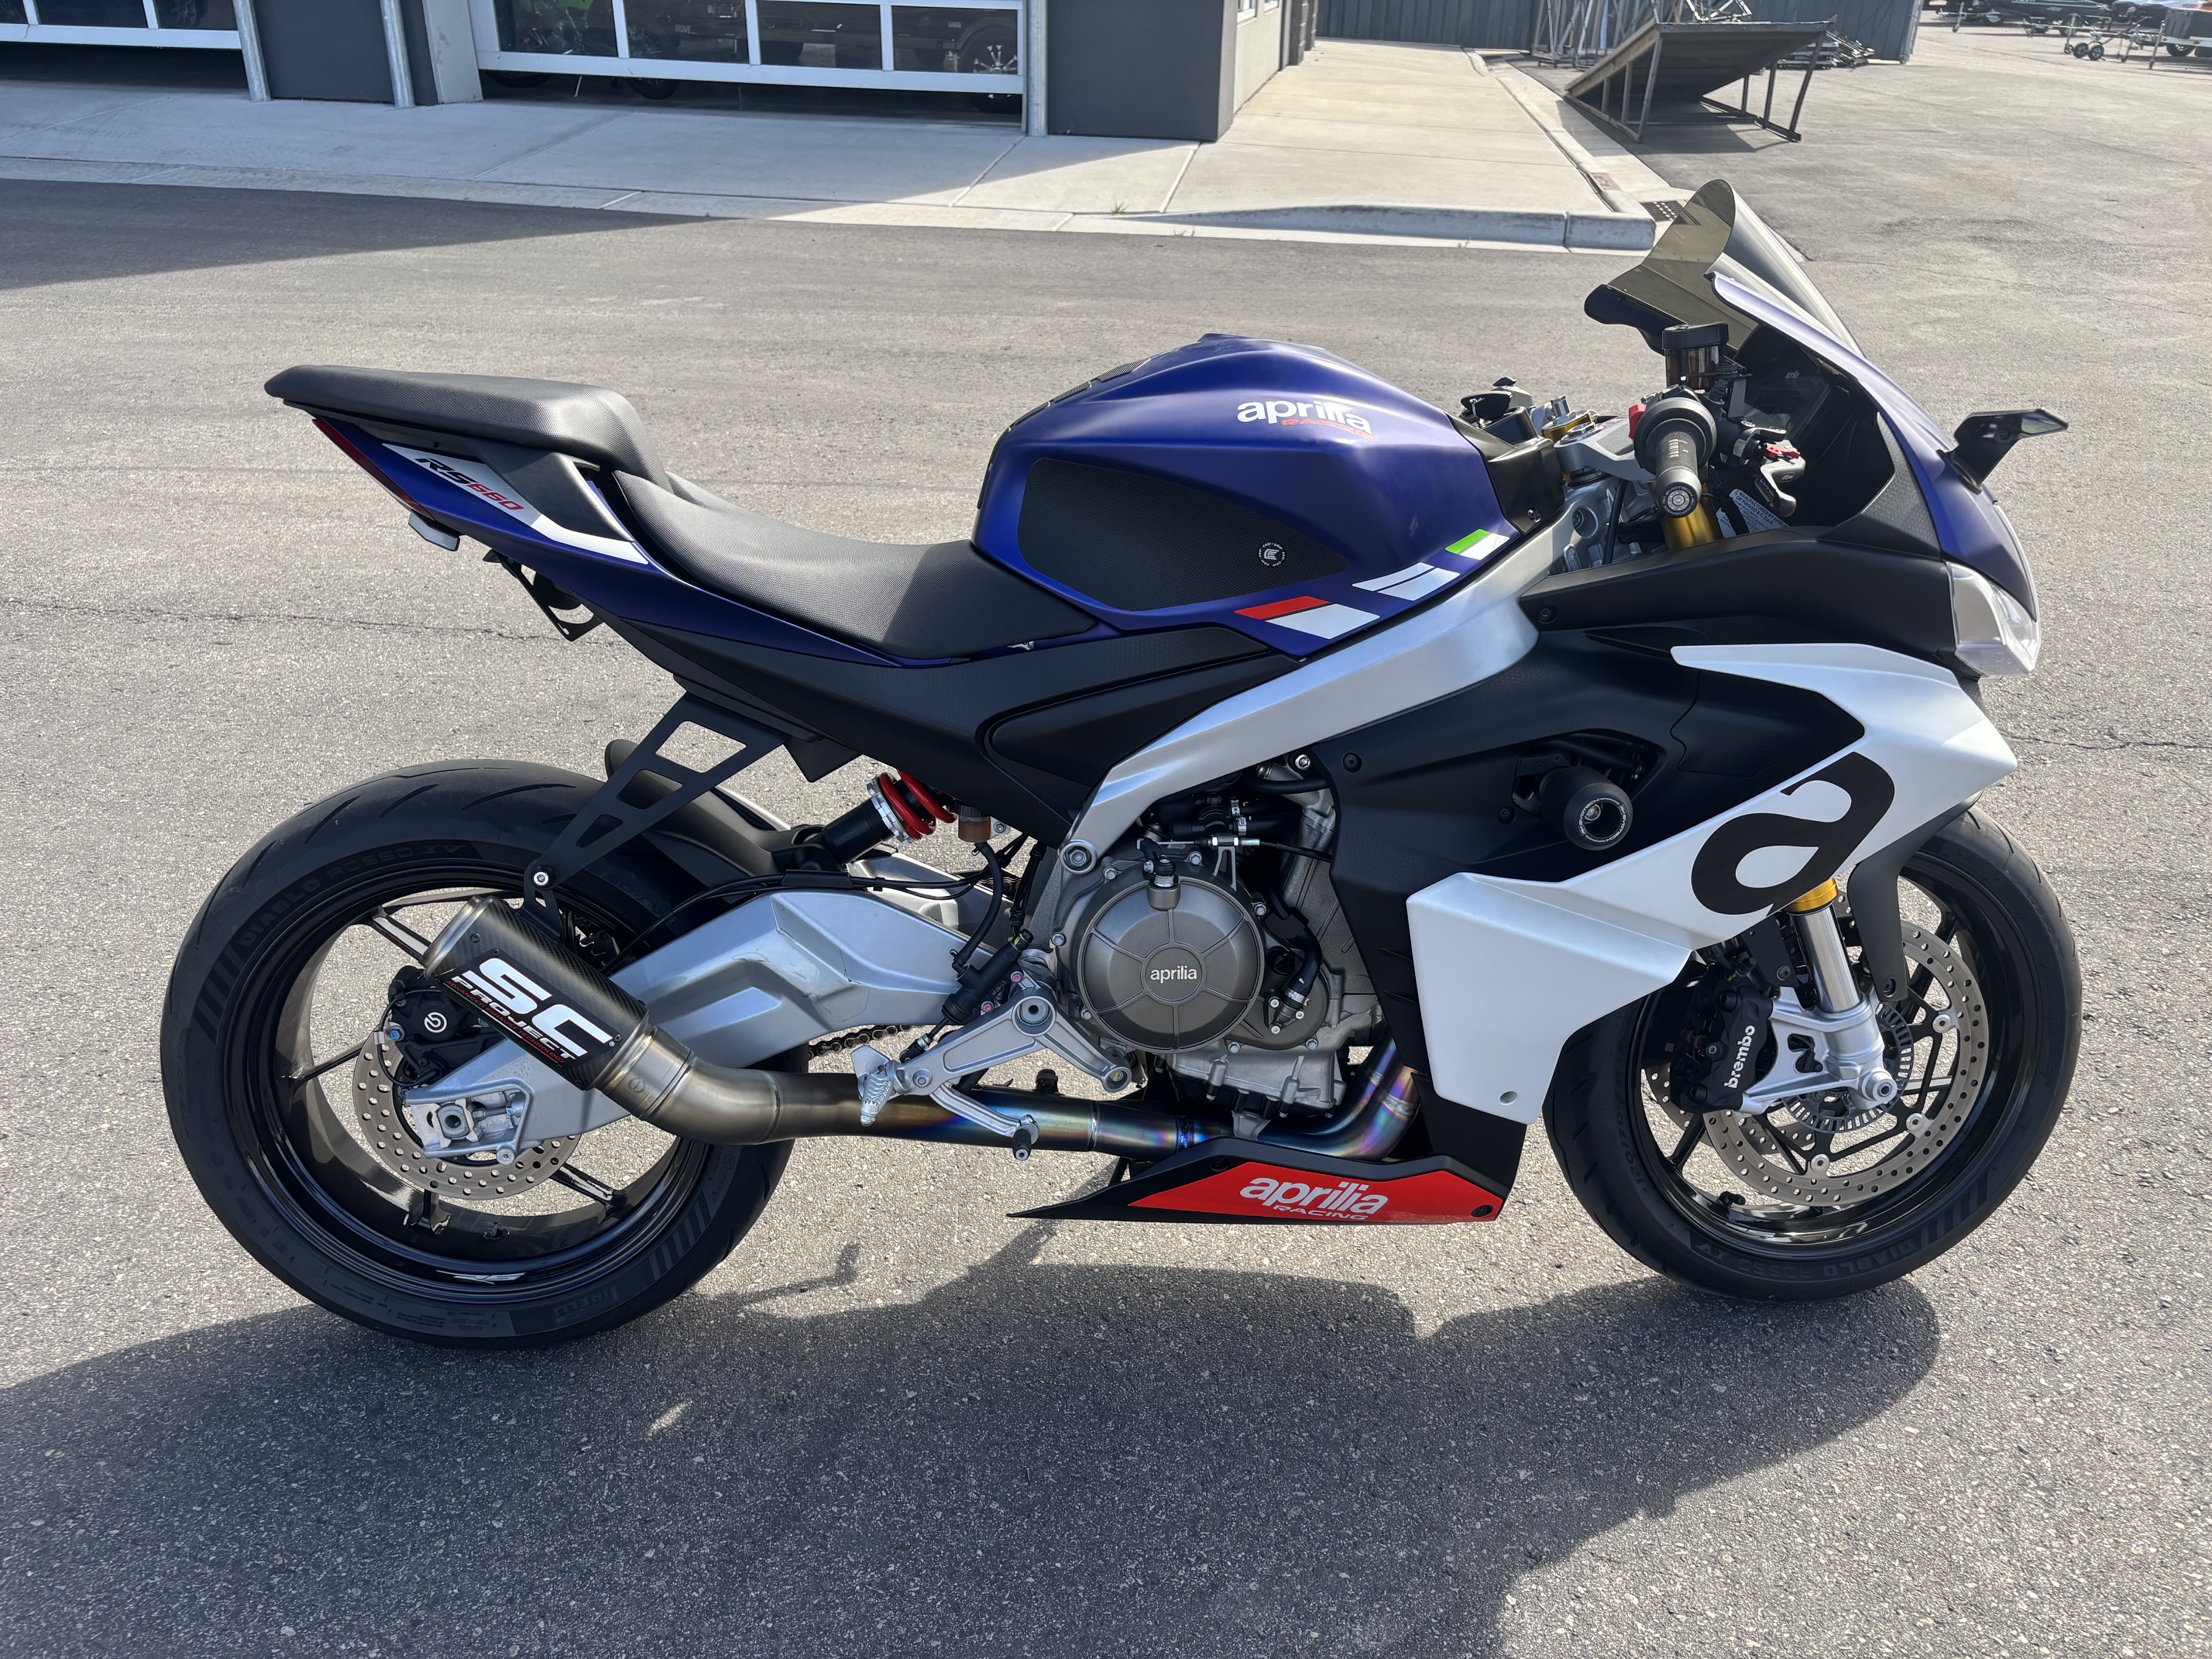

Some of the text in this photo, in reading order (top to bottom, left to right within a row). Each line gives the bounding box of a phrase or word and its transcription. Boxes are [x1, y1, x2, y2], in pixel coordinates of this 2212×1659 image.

[1237, 400, 1373, 435] aprilia
[1280, 418, 1374, 443] RACING
[1665, 486, 1694, 497] EVOTECH
[1738, 491, 1769, 515] MANUFACTURED
[1741, 499, 1757, 513] PIAGGIO
[1578, 799, 1599, 826] EVOTECH
[1606, 814, 1626, 842] EVOTECH
[237, 878, 322, 948] DIABLO
[326, 846, 414, 880] ROSSO
[1149, 965, 1197, 984] aprilia
[451, 975, 576, 1061] PROJECT
[462, 957, 613, 1057] SC
[446, 981, 566, 1064] ADVANCED EXHAUST TECHNOLOGY
[1724, 1025, 1756, 1089] brembo
[1240, 1176, 1389, 1214] aprilia
[1273, 1204, 1369, 1221] RACING
[1737, 1257, 1814, 1279] ROSSO
[1822, 1238, 1918, 1278] DIABLO
